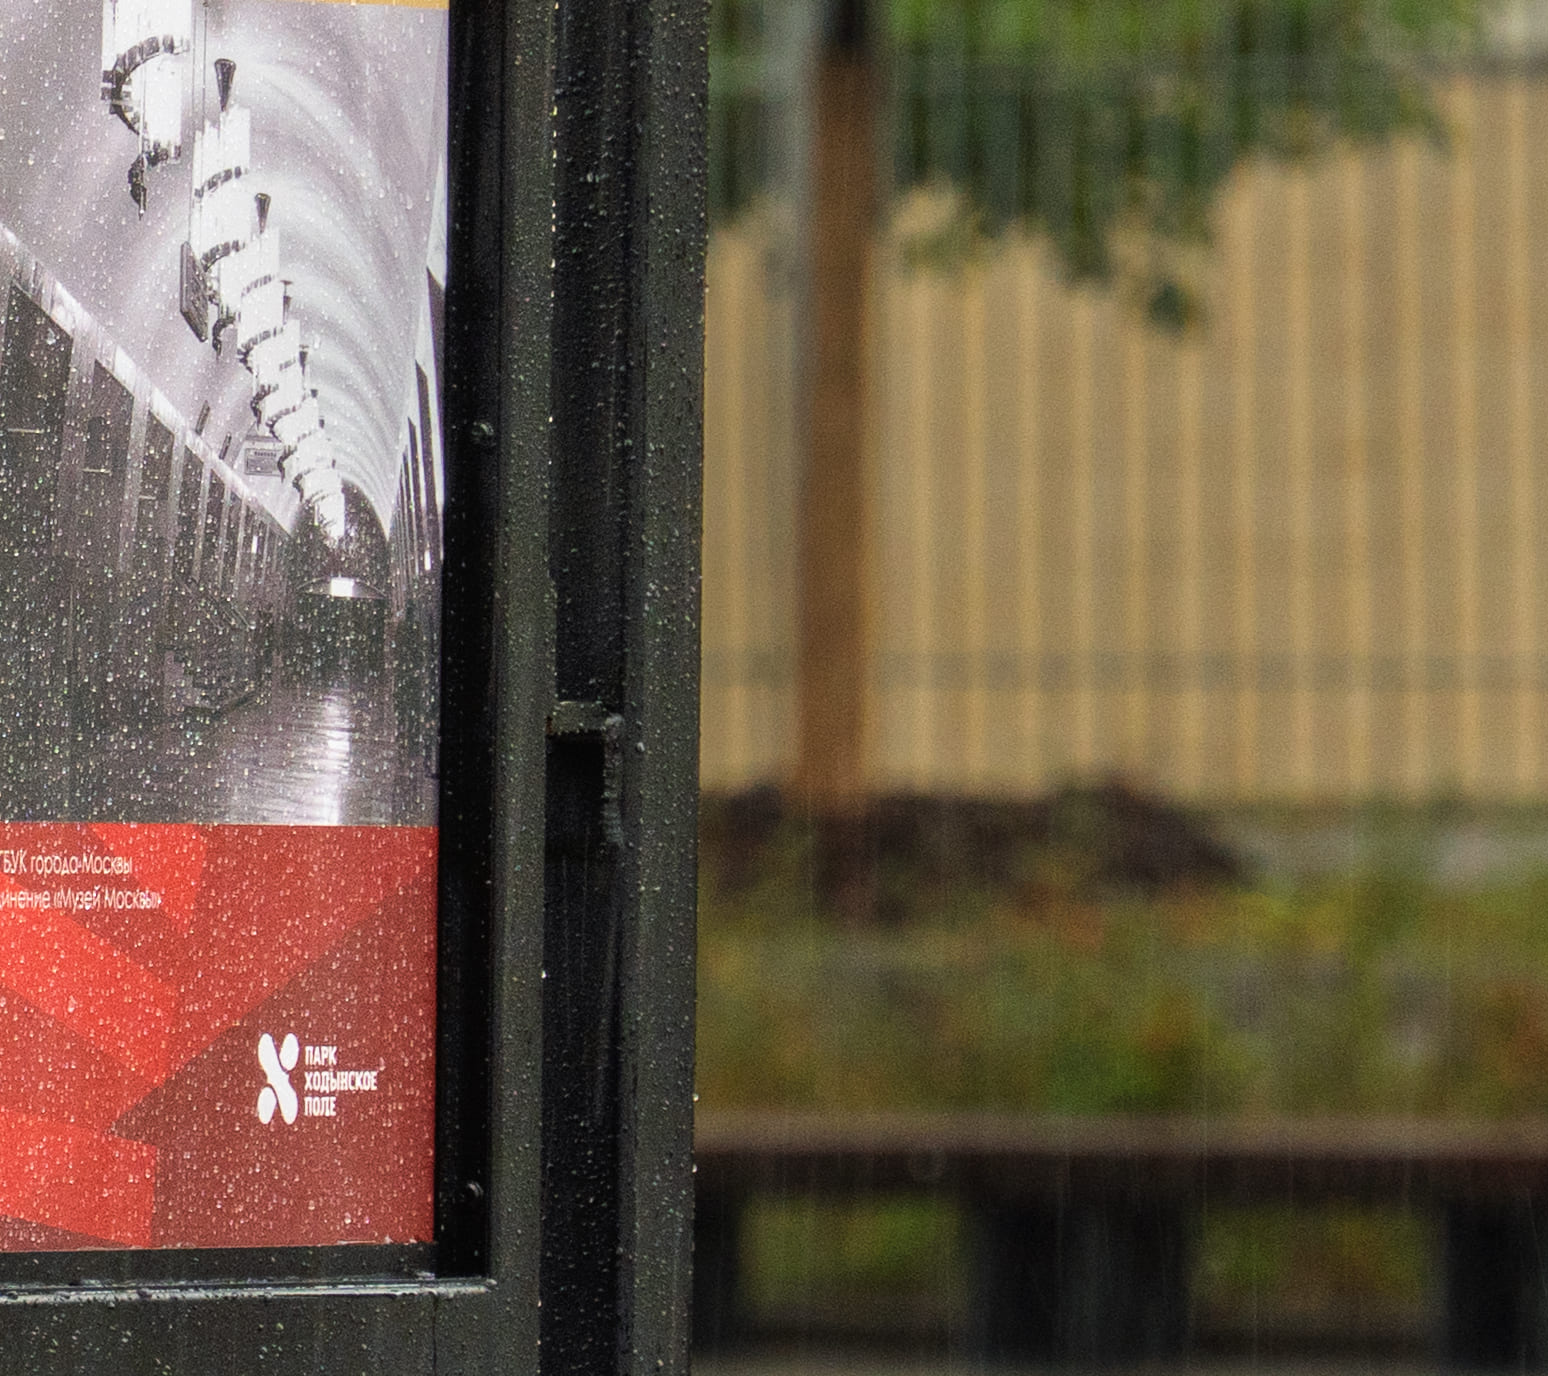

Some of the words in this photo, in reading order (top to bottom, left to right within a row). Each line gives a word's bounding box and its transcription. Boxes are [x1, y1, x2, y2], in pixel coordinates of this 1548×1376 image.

[30, 855, 78, 876] города
[82, 854, 132, 874] Москвы
[54, 886, 100, 911] «Музей
[104, 888, 160, 910] Москвы»
[305, 1046, 337, 1065] ПАРК
[305, 1071, 378, 1093] ХОДЫНСКОЕ
[304, 1096, 336, 1116] ПОЛЕ
